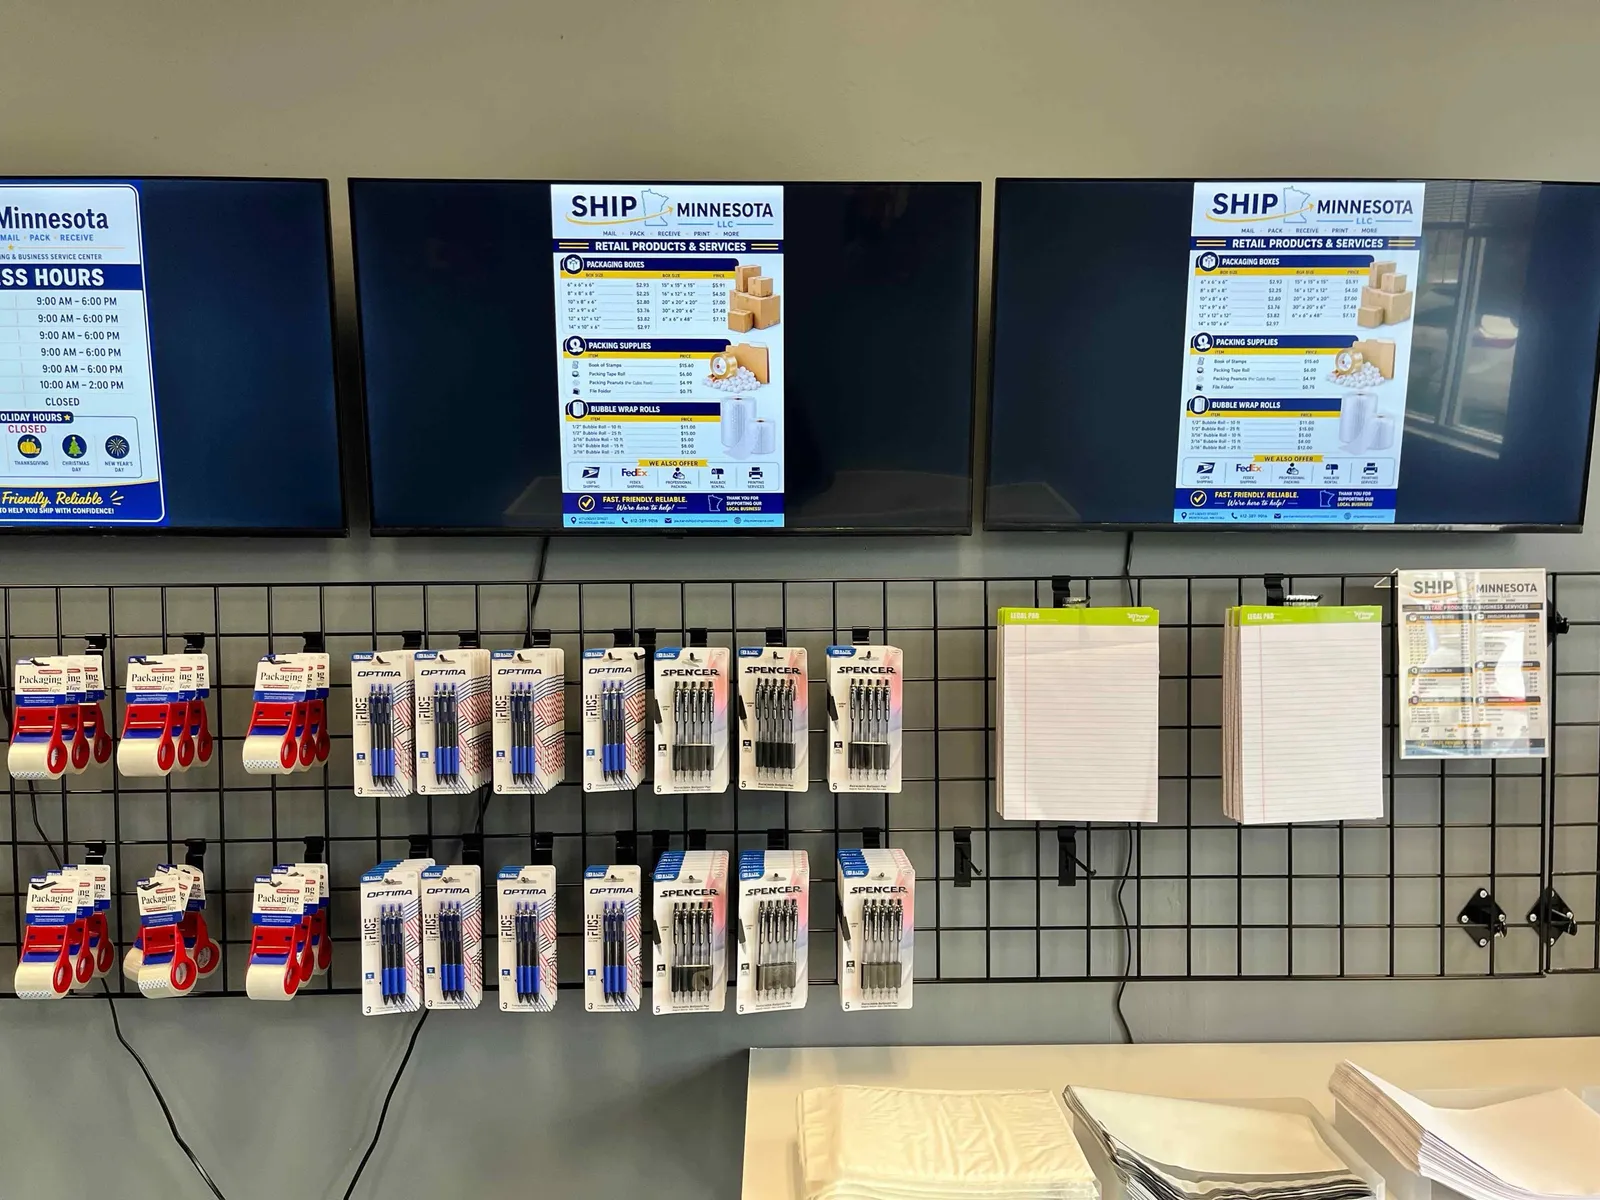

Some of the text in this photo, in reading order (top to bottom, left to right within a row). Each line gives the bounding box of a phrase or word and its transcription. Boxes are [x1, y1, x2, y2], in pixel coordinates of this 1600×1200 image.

[571, 195, 774, 218] SHIP MINNESOTA
[1212, 193, 1413, 215] SHIP MINNESOTA
[0, 206, 109, 229] Minnesota
[1356, 217, 1373, 225] LLC
[595, 242, 746, 251] RETAIL PRODUCTS & SERVICES
[1232, 239, 1384, 248] RETAIL PRODUCTS & SERVICES
[587, 261, 645, 269] PACKAGING BOXES
[1222, 258, 1280, 266] PACKAGING BOXES
[0, 268, 104, 286] SS HOURS
[36, 297, 117, 306] 9:00 AM 6:00 PM
[38, 315, 119, 323] 9:00 AM 6:00 PM
[39, 331, 120, 340] 9:00 AM 6:00 PM
[588, 342, 651, 350] PACKING SUPPLIES
[1216, 338, 1278, 346] PACKING SUPPLIES
[41, 348, 121, 357] 9:00 AM 6:00 PM
[42, 365, 123, 374] 9:00 AM 6:00 PM
[40, 381, 124, 390] 10:00 AM 2:00 PM
[45, 398, 80, 406] CLOSED
[1212, 401, 1280, 409] BUBBLE WRAP ROLLS
[590, 405, 660, 413] BUBBLE WRAP ROLLS
[32, 413, 62, 422] HOURS
[8, 425, 47, 434] CLOSED
[621, 468, 648, 477] FedEx
[1236, 464, 1262, 473] FedEx
[1, 491, 104, 508] Friendly. Reliable
[1215, 491, 1299, 499] FAST. FRIENDLY. RELIABLE.
[658, 504, 675, 512] help!
[1413, 580, 1538, 594] SHIP MINNESOTA
[1028, 611, 1040, 619] PAD
[1247, 612, 1275, 620] LEGAL PAD
[357, 670, 401, 678] OPTIMA
[497, 668, 542, 676] OPTIMA
[588, 667, 632, 675] OPTIMA
[661, 668, 720, 677] SPENCER
[744, 666, 802, 675] SPENCER
[836, 666, 897, 674] SPENCER
[19, 675, 62, 685] Packaging
[131, 672, 176, 684] Packaging
[260, 671, 304, 683] Packaging
[367, 889, 413, 898] OPTIMA
[426, 887, 470, 895] OPTIMA
[503, 888, 547, 896] OPTIMA
[589, 887, 634, 895] OPTIMA
[660, 888, 720, 898] SPENCER
[745, 886, 802, 896] SPENCER
[849, 886, 909, 894] SPENCER
[31, 894, 73, 904] Packaging
[141, 893, 177, 905] Packaging
[257, 893, 300, 904] Packaging
